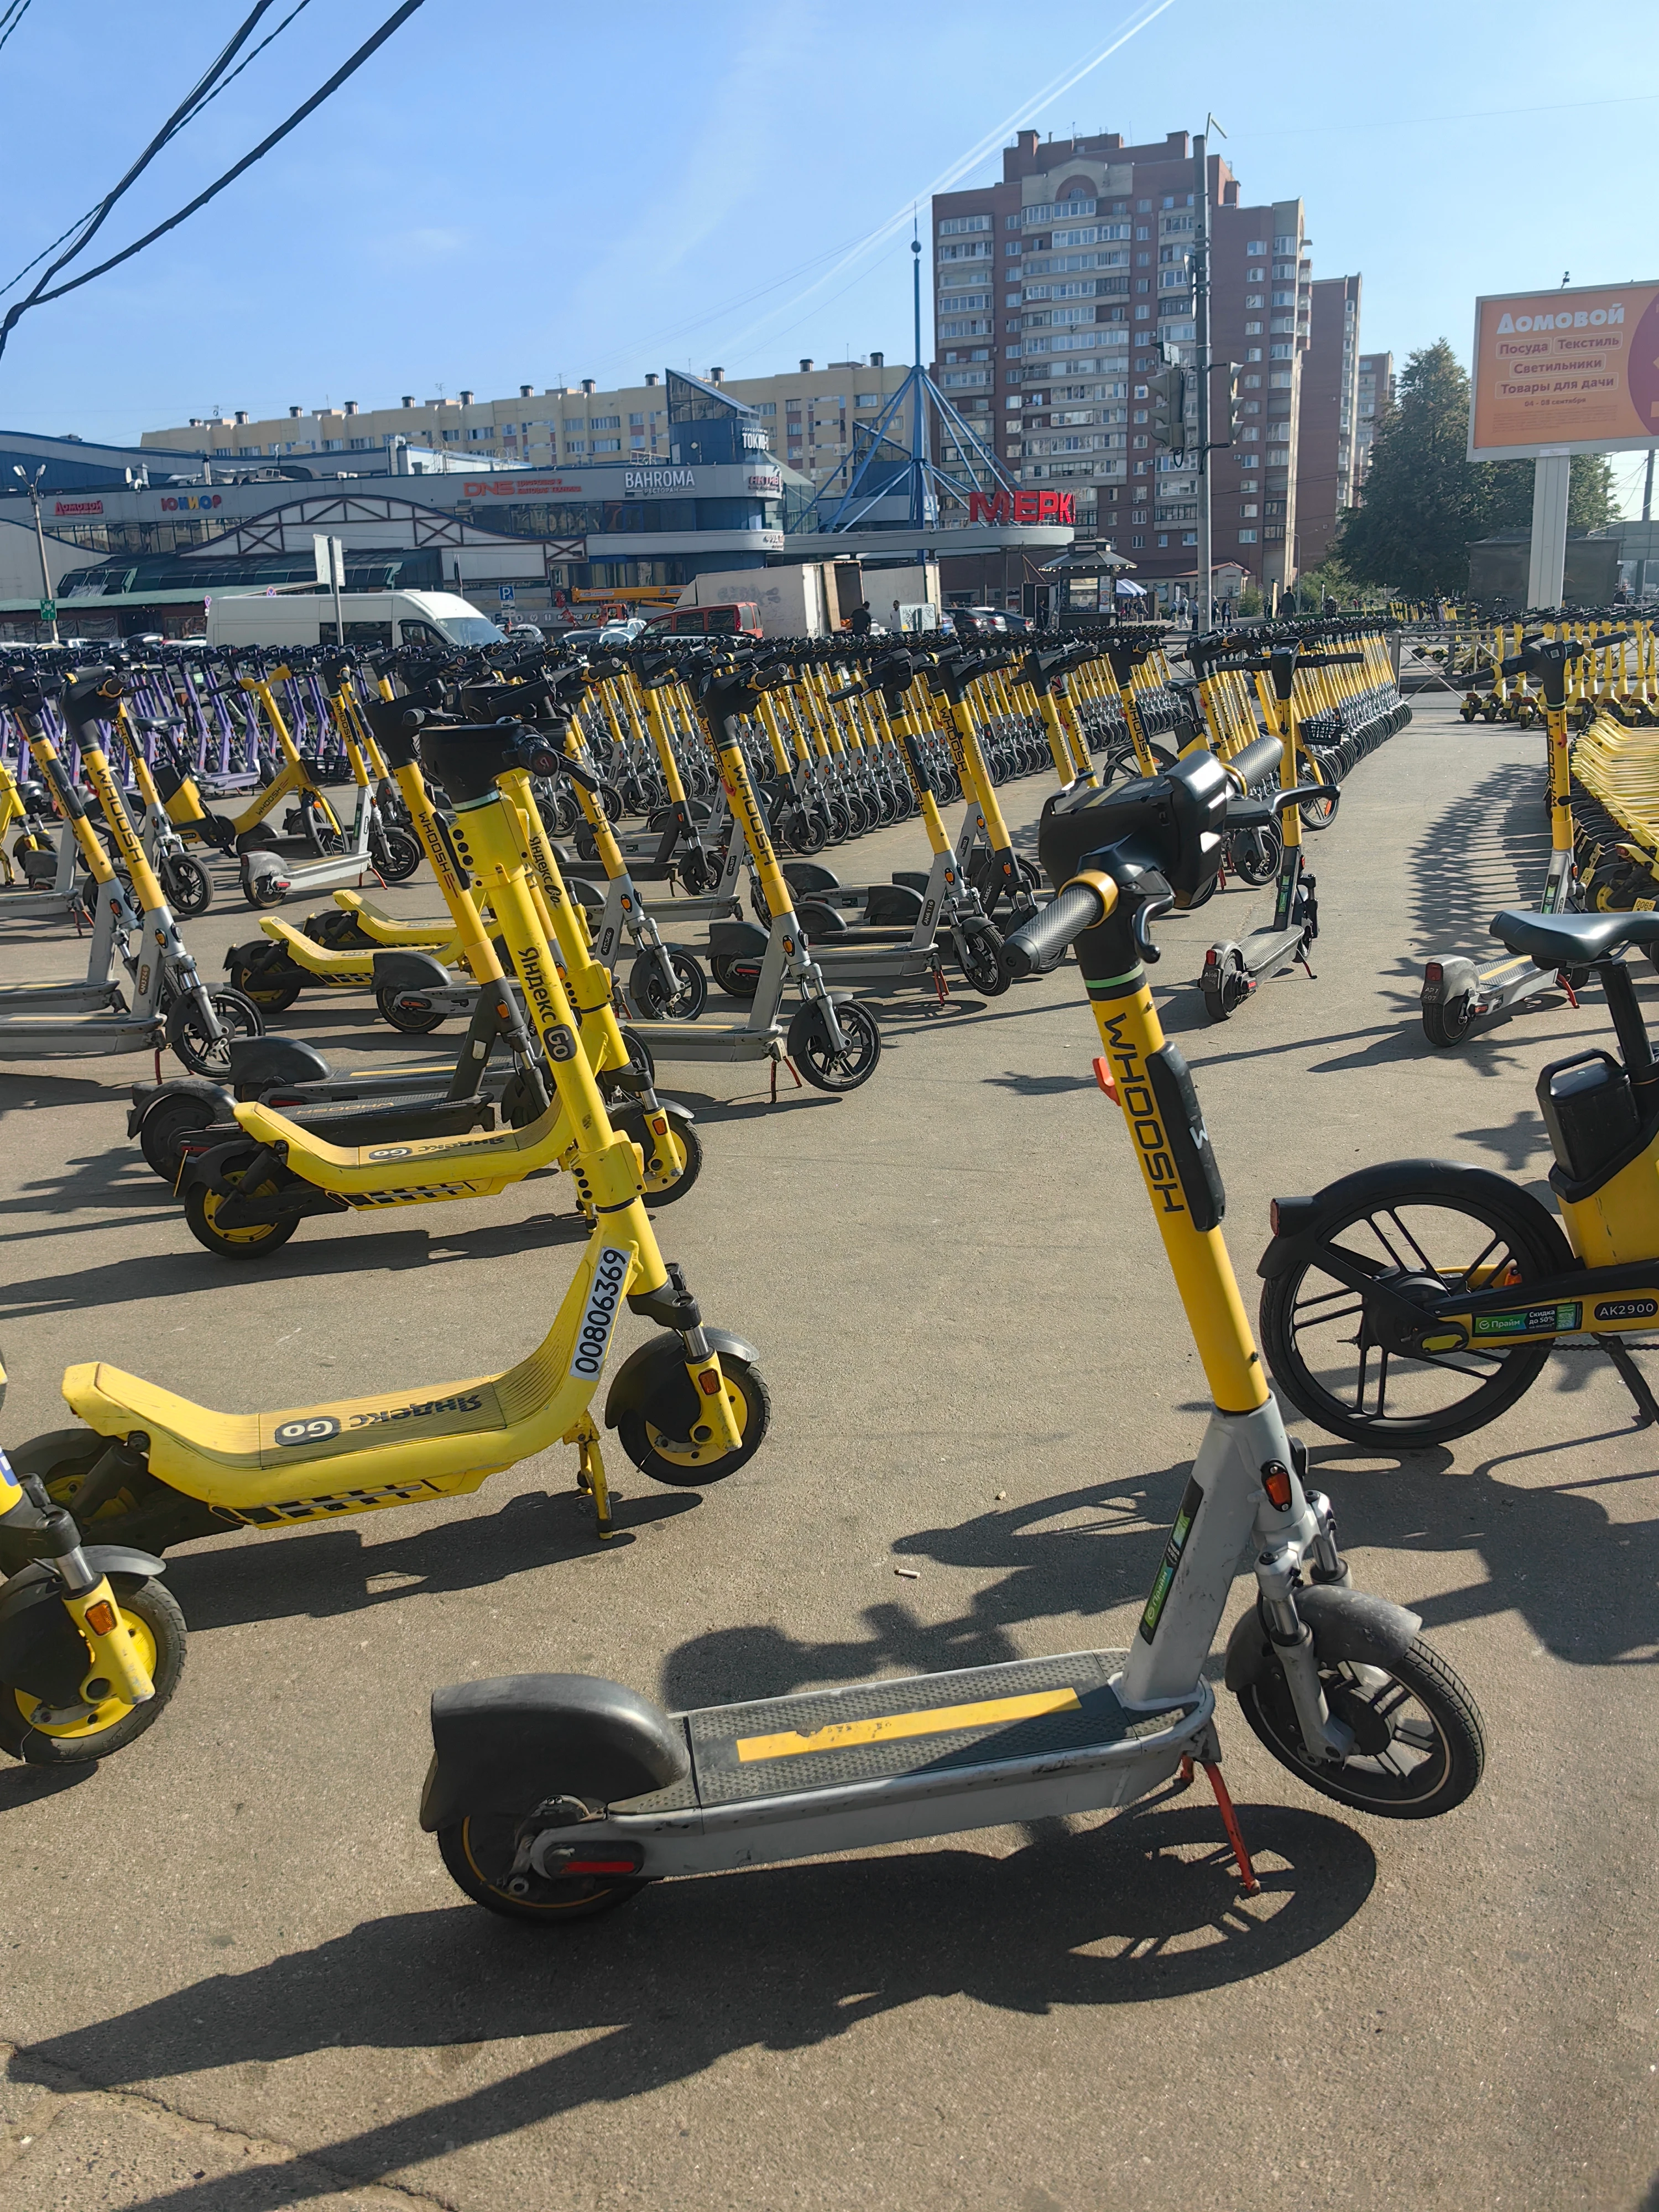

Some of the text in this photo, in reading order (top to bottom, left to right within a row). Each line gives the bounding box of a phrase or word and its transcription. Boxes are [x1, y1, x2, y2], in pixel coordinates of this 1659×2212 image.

[1496, 303, 1625, 334] Домовой
[1500, 343, 1548, 356] Посуда
[1558, 336, 1620, 349] Текстиль
[1514, 359, 1602, 374] Светильники
[1501, 377, 1614, 395] Товары для дачи
[463, 481, 515, 497] DNS
[625, 470, 695, 488] BAHROMA
[55, 500, 103, 515] Домовой
[161, 494, 222, 512] ЮНИОР
[334, 700, 353, 742] WHOOSH
[784, 688, 802, 736] WHOOSH
[804, 686, 821, 733] WHOOSH
[1208, 691, 1228, 750] WHOOSH
[940, 706, 968, 773] WHOOSH
[1055, 722, 1070, 761] WHOOSH
[1126, 698, 1151, 763] WHOOSH
[969, 731, 985, 772] WHOOSH
[97, 768, 144, 863] WHOOSH
[255, 786, 283, 816] WHOOSH
[733, 764, 775, 867] WHOOSH
[418, 811, 451, 873] WHOOSH
[529, 836, 562, 904] Яндекс Go
[924, 901, 934, 925] AN6116
[1636, 900, 1654, 910] 0065
[518, 947, 570, 1060] Яндекс Go
[296, 1102, 395, 1114] WHOOSH
[1104, 1013, 1185, 1213] WHOOSH
[374, 1137, 505, 1159] Яндекс Go
[575, 1248, 627, 1374] 00806369
[1491, 1318, 1520, 1329] Прайм
[1529, 1309, 1555, 1318] Скидка
[1600, 1303, 1654, 1317] AK2900
[282, 1394, 482, 1437] Яндекс Go
[1152, 1571, 1167, 1607] Прайм
